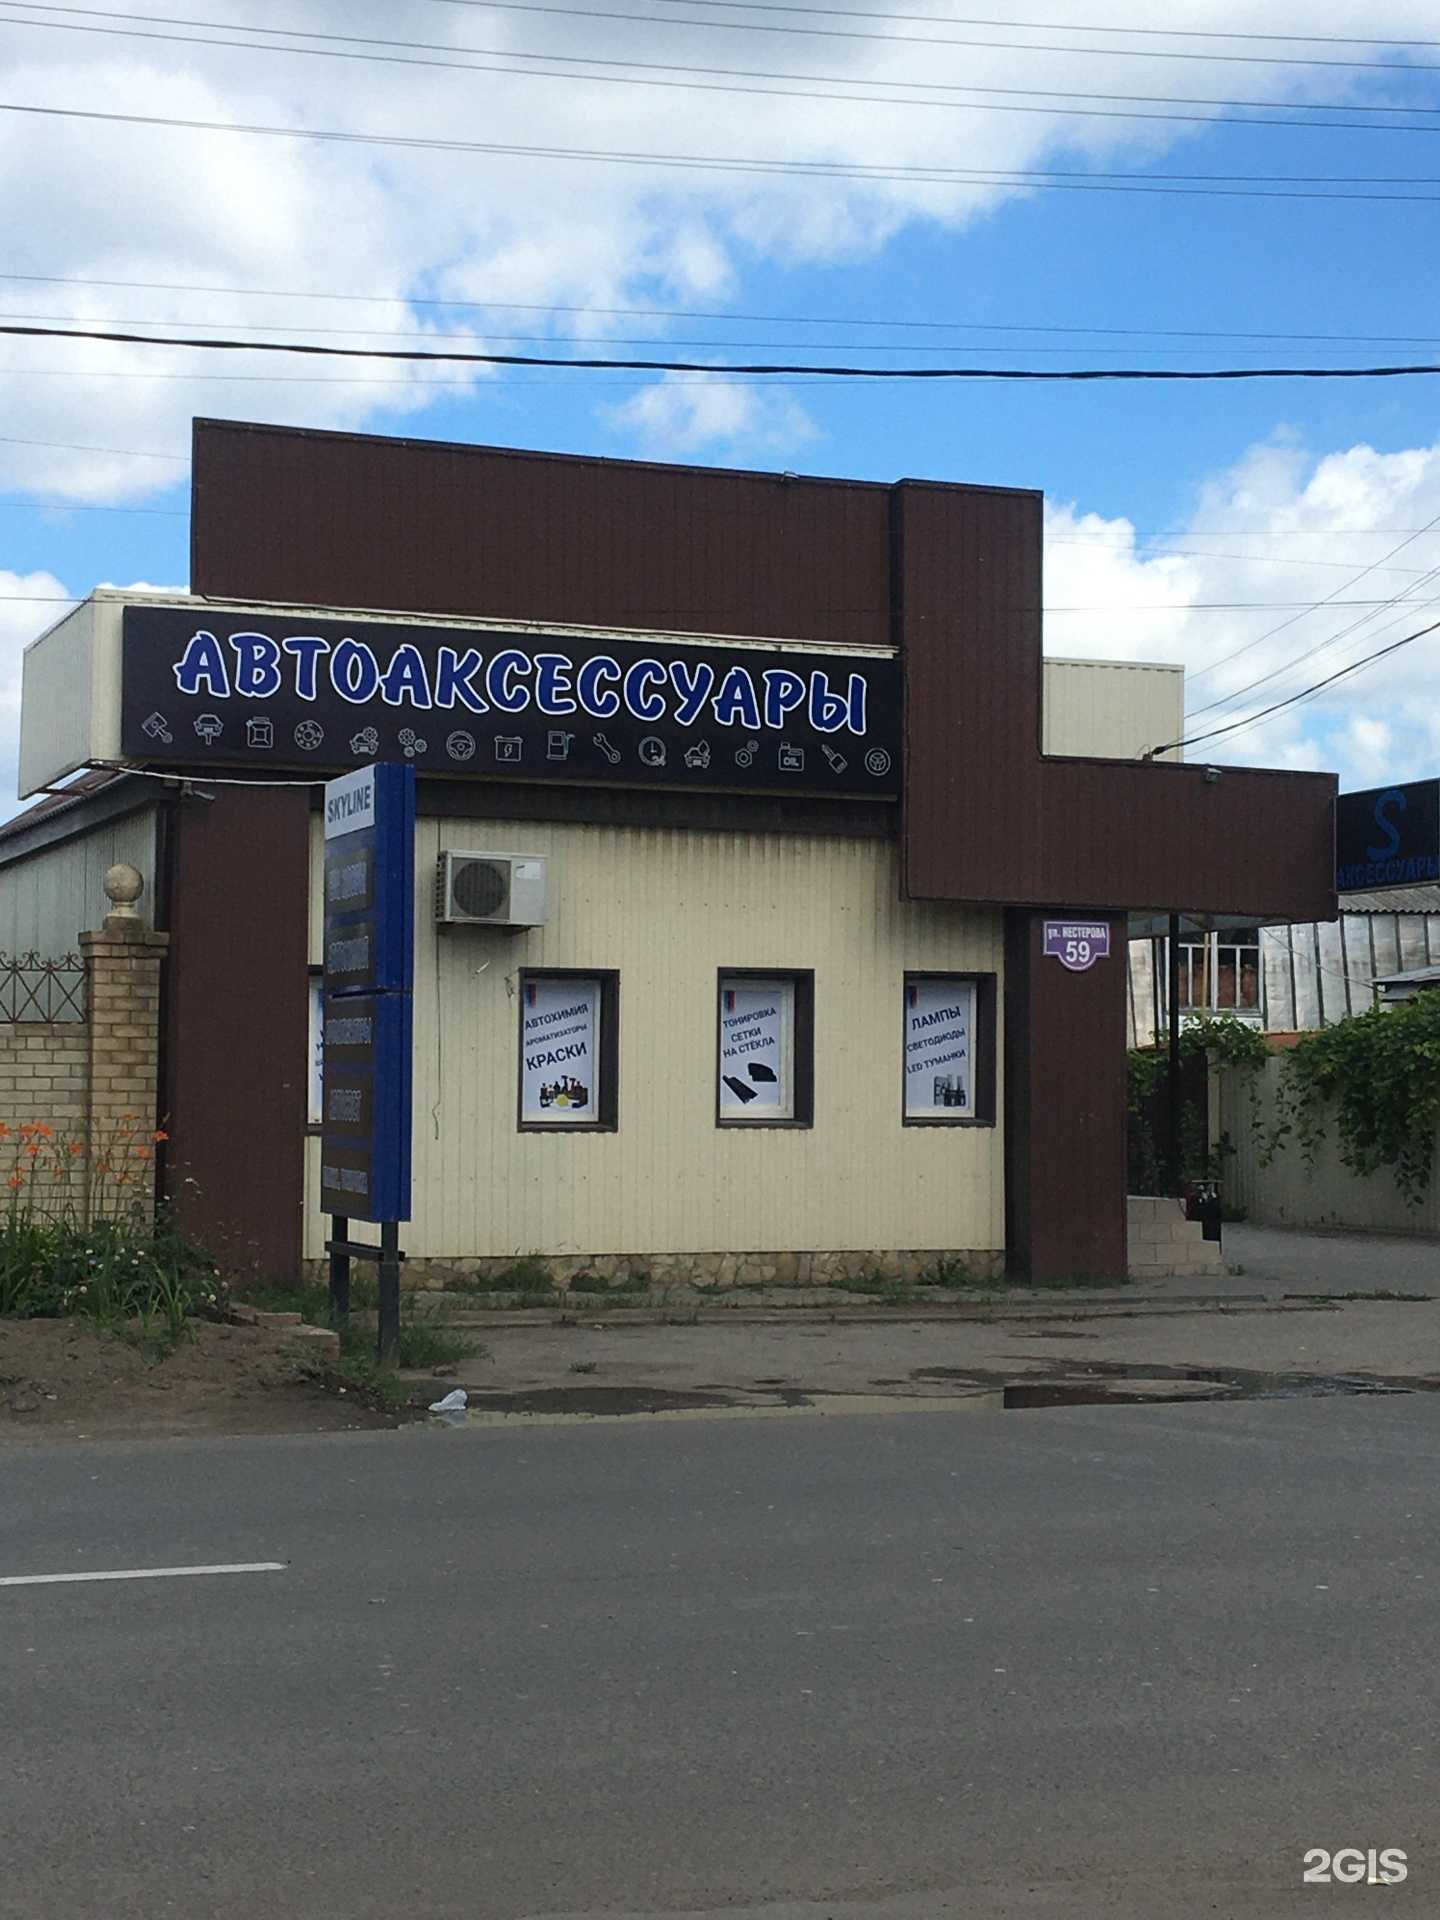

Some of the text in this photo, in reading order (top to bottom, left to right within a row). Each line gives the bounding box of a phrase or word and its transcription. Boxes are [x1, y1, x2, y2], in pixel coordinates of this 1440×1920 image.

[173, 630, 868, 735] АВТОАКСЕССУАРЫ
[327, 785, 371, 823] SKYLINE
[1366, 789, 1408, 862] S
[1062, 927, 1106, 939] НЕСТЕРОВА
[1066, 941, 1091, 963] 59
[525, 1003, 589, 1030] АВТОХИМИЯ
[723, 1007, 777, 1028] ТОНИРОВКА
[912, 1006, 961, 1030] ЛАМПЫ
[526, 1024, 588, 1046] АРОМАТИЗАТОРЫ
[731, 1027, 762, 1042] СЕТКИ
[907, 1027, 966, 1052] СВЕТОДИОДЫ
[526, 1042, 587, 1071] КРАСКИ
[723, 1048, 737, 1058] НА
[907, 1049, 966, 1074] LED ТУМАНКИ
